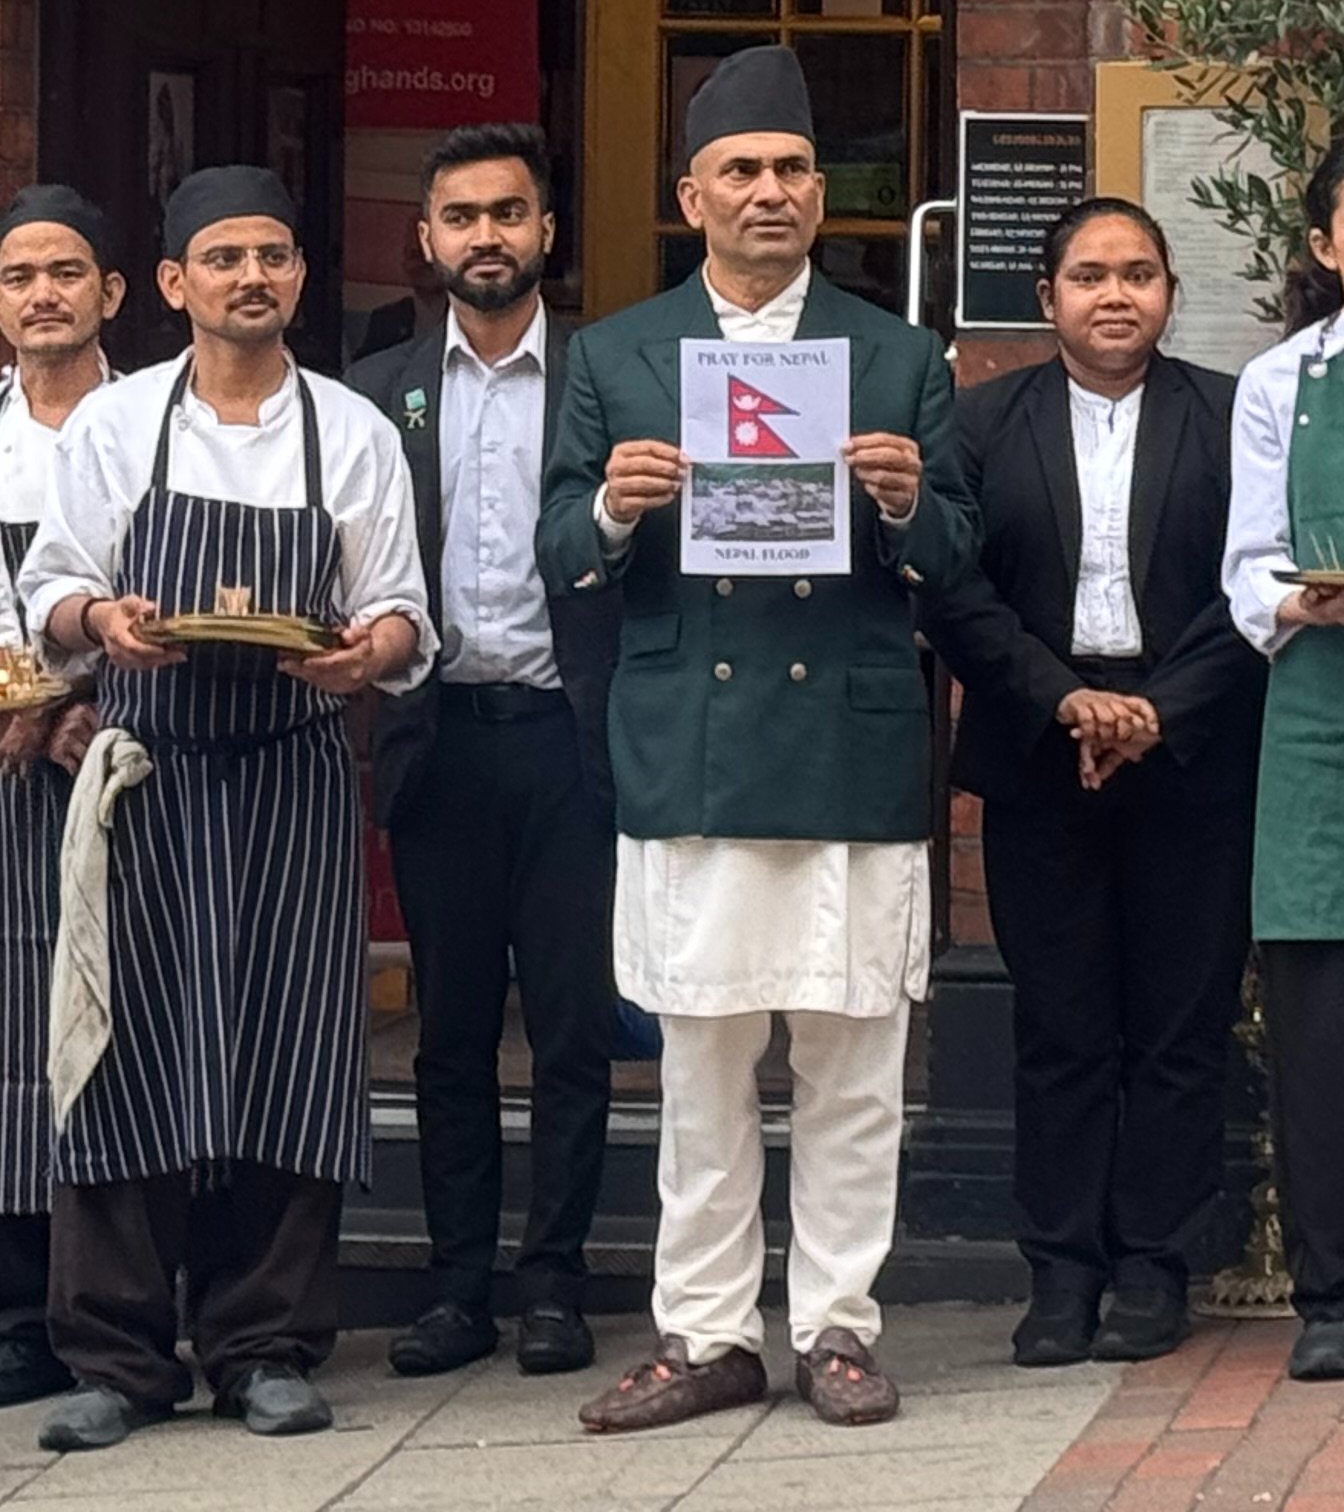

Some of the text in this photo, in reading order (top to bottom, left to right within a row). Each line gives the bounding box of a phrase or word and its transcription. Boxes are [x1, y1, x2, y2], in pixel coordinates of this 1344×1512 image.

[697, 350, 829, 367] PRAY FOR NEPAL
[714, 548, 811, 561] NEPAL FLOOD
